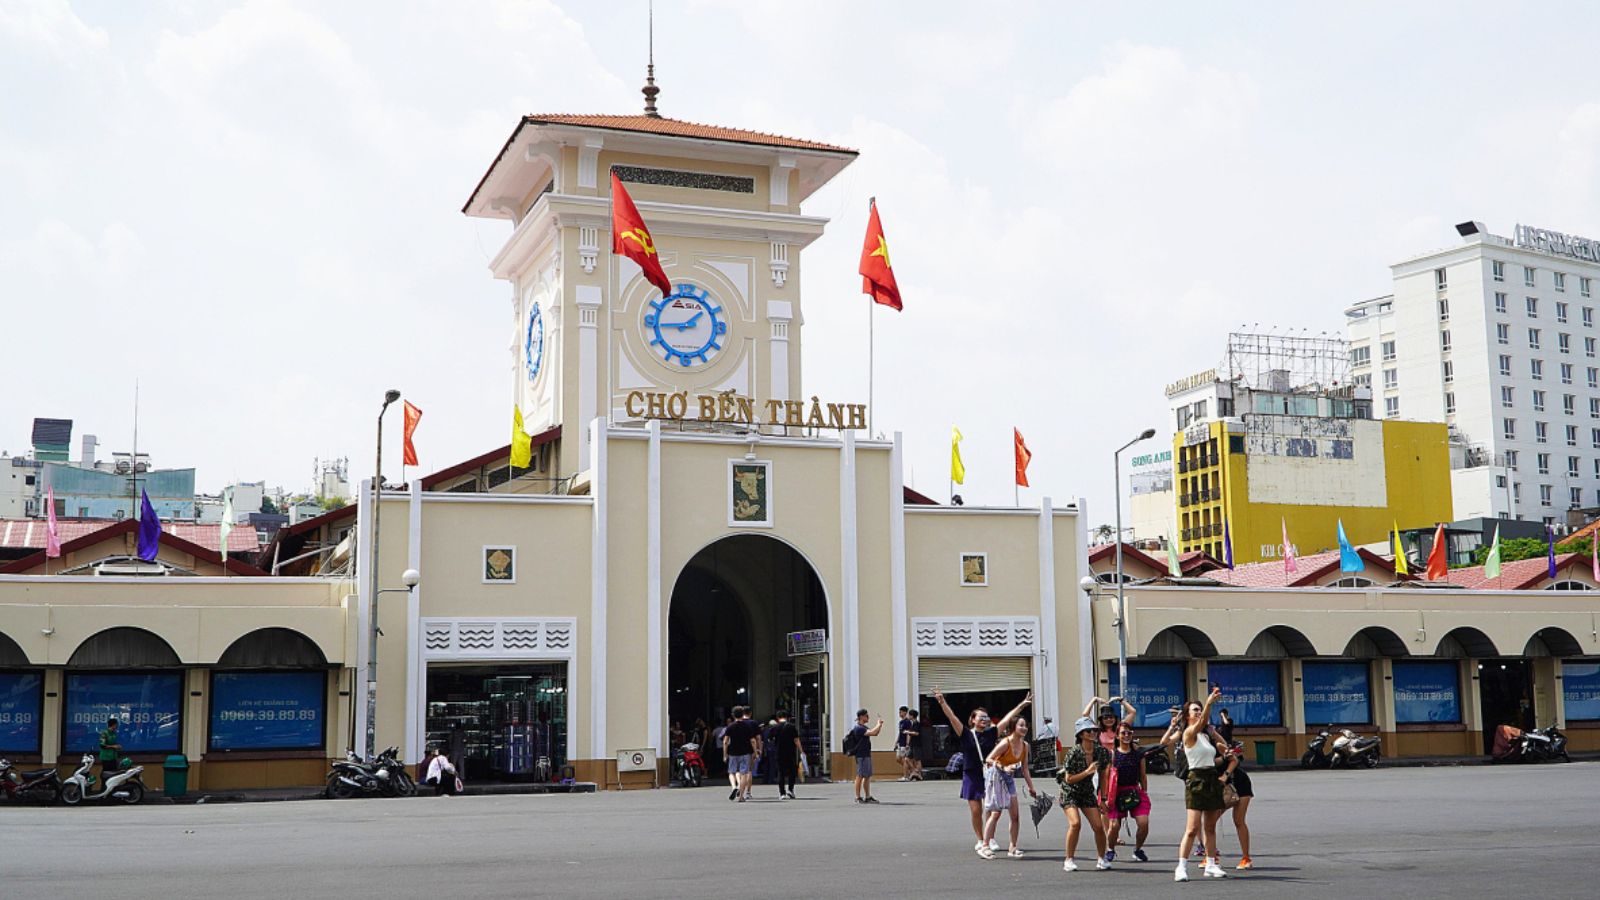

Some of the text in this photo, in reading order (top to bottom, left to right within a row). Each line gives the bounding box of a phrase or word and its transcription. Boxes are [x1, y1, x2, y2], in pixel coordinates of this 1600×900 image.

[697, 388, 755, 423] BẾN
[764, 396, 867, 429] THÀNH
[220, 709, 316, 721] 0969.39.89.89
